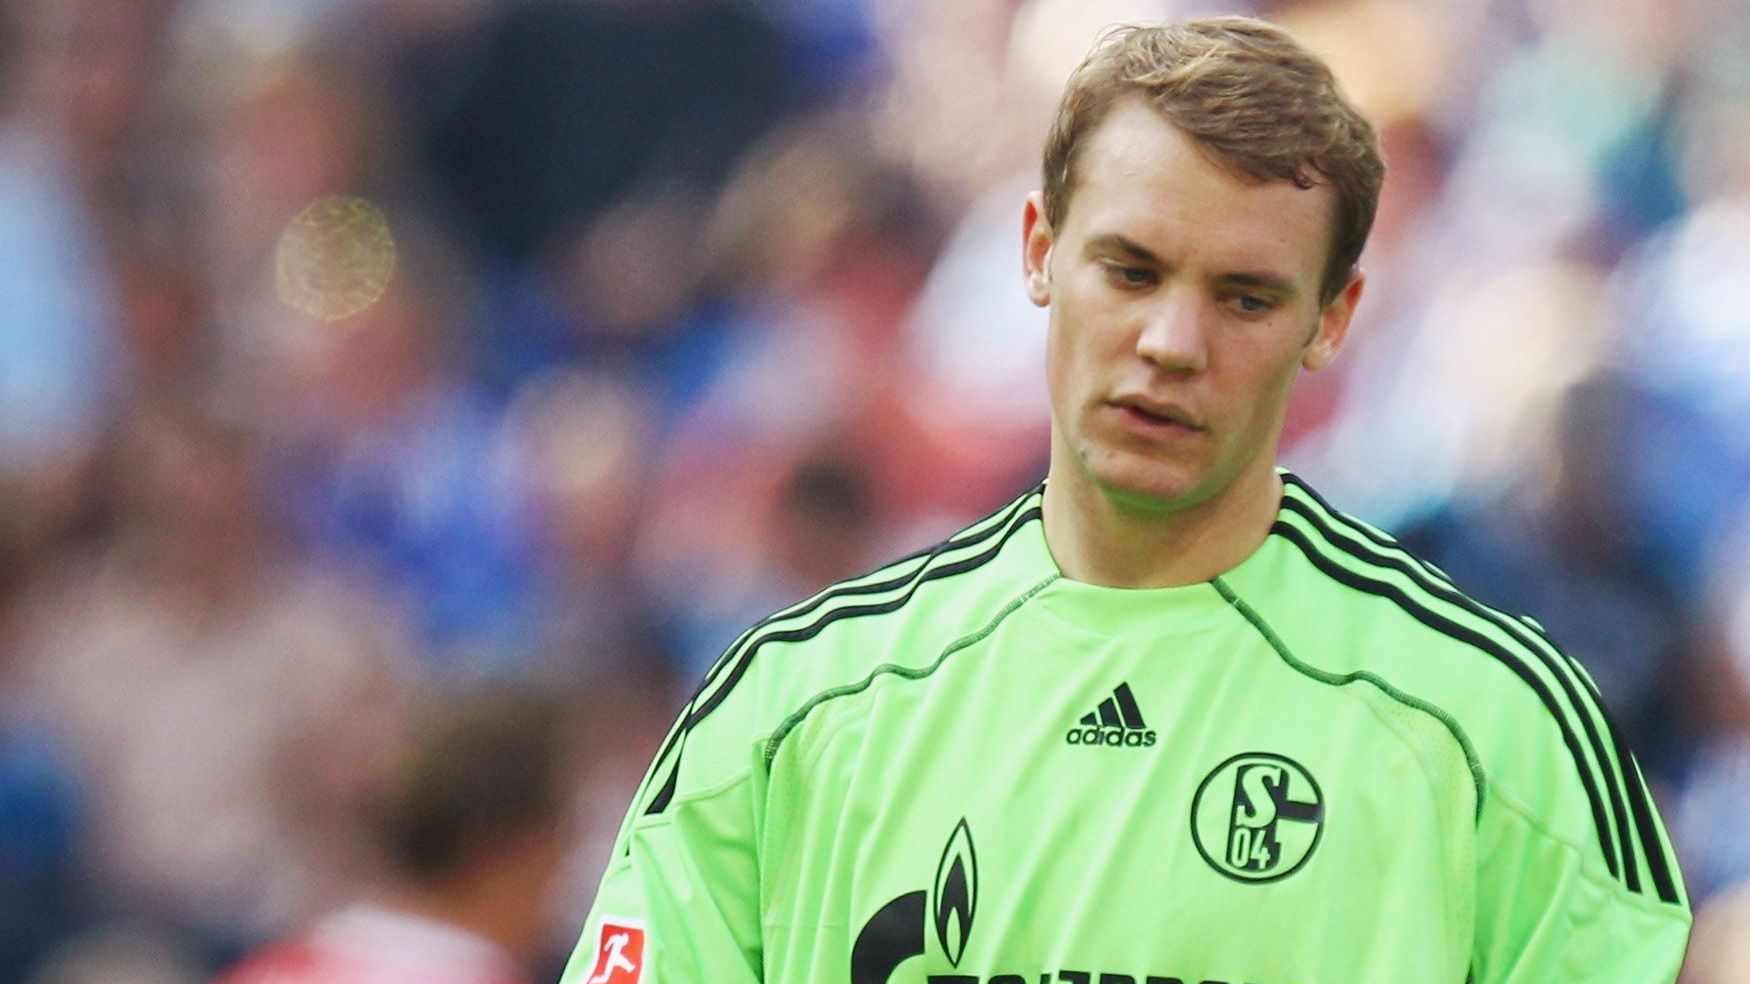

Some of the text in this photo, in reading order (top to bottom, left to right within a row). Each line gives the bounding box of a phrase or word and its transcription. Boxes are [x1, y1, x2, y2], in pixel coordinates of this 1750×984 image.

[1065, 726, 1157, 748] adidas
[1237, 764, 1281, 830] S
[1231, 828, 1271, 871] 04
